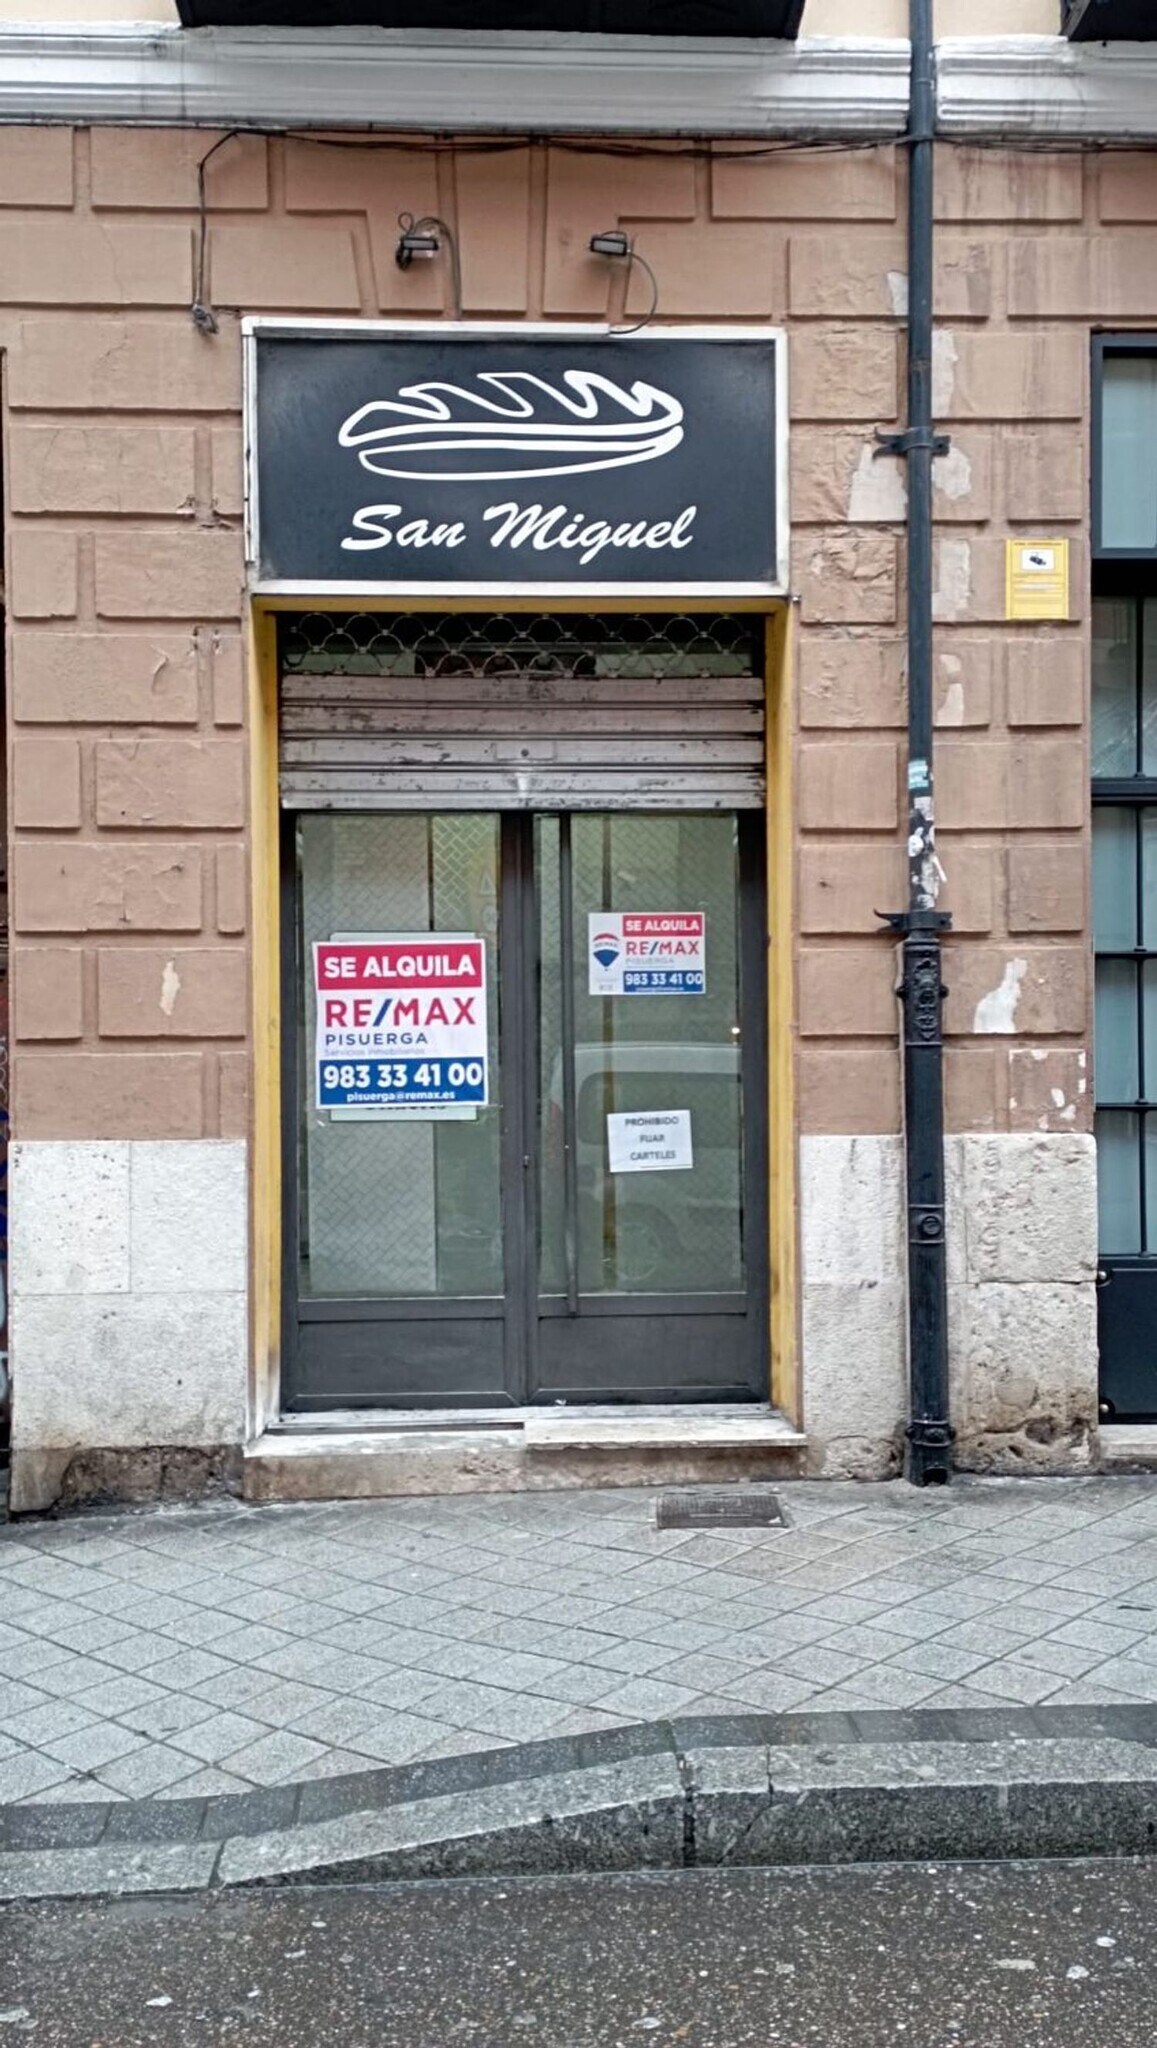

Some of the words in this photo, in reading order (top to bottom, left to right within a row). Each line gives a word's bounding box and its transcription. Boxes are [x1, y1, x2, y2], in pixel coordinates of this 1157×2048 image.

[340, 504, 466, 550] San
[483, 502, 697, 565] Miguel
[625, 920, 641, 931] SE
[645, 920, 700, 931] ALQUILA
[626, 941, 699, 955] RE/MAX
[324, 956, 357, 978] SE
[363, 954, 475, 978] ALQUILA
[625, 973, 648, 985] 983
[651, 973, 666, 985] 33
[669, 973, 683, 985] 41
[686, 973, 702, 985] 00
[325, 997, 476, 1028] RE/MAX
[326, 1032, 428, 1046] PISUERGA
[324, 1065, 370, 1089] 983
[377, 1064, 408, 1087] 33
[414, 1063, 441, 1086] 41
[448, 1063, 482, 1086] 00
[347, 1091, 455, 1102] pisuerga@remax.es
[625, 1116, 679, 1126] PROHIBIDO
[630, 1150, 676, 1160] CARTELES
